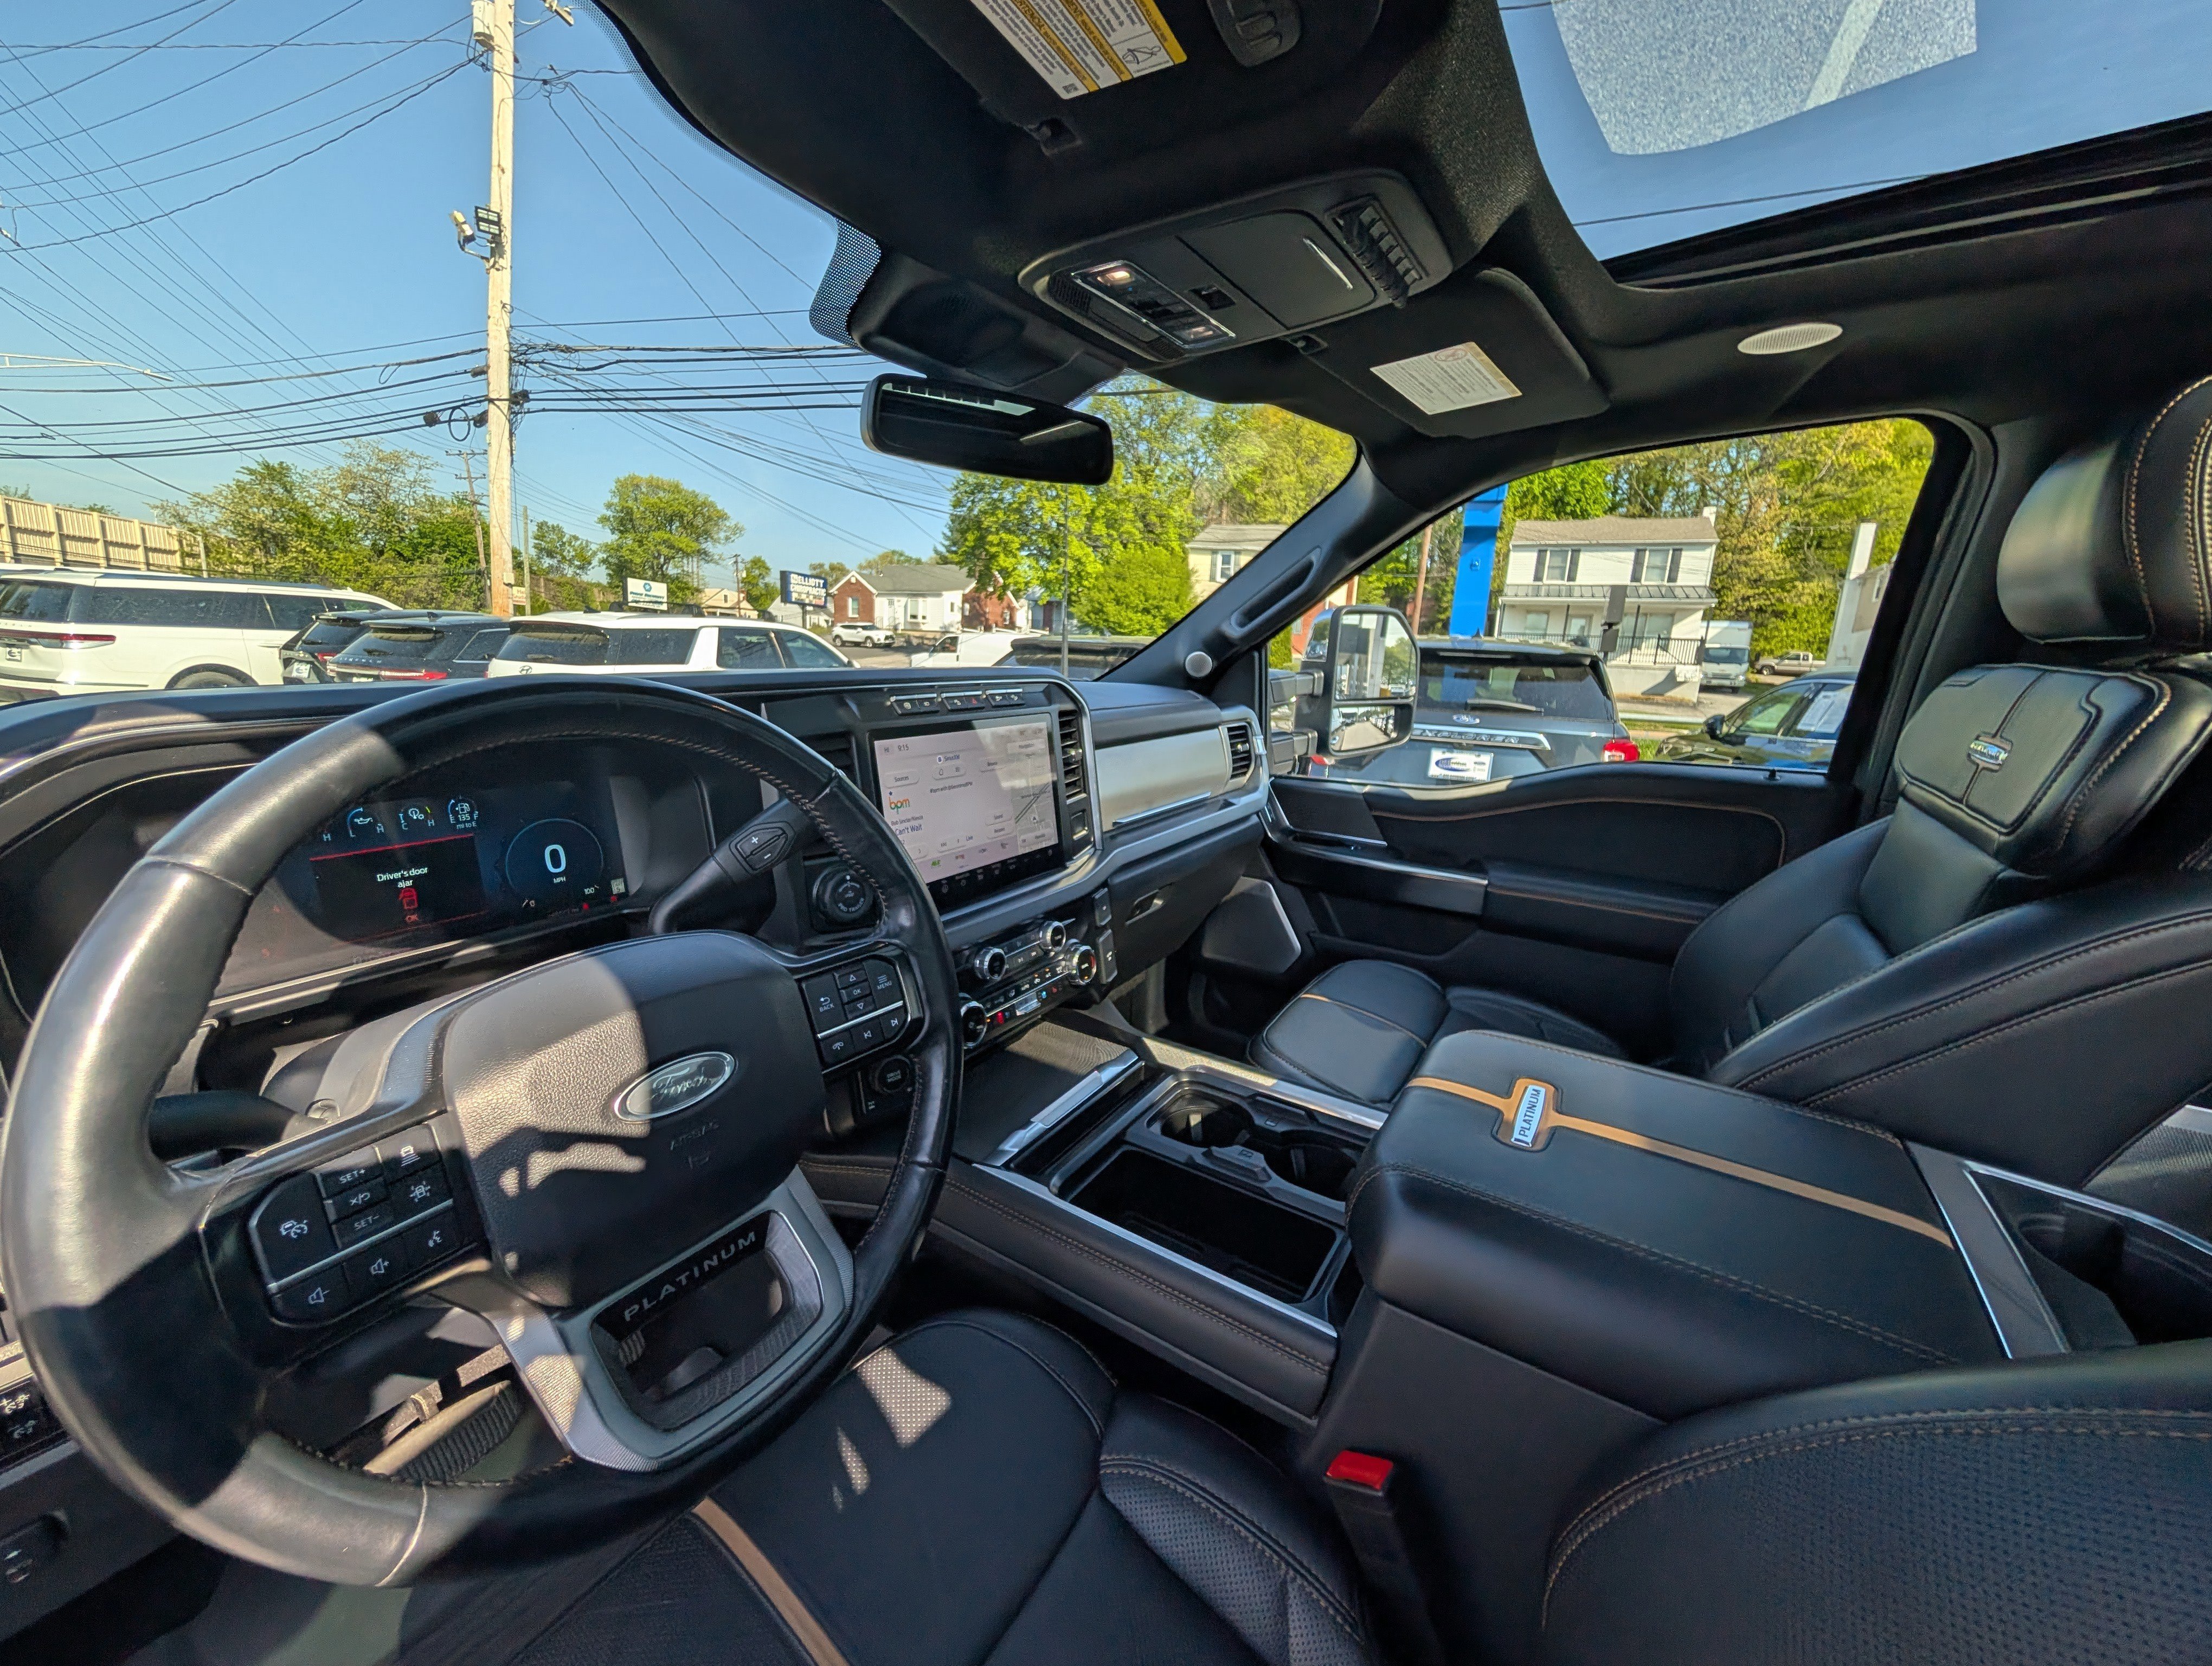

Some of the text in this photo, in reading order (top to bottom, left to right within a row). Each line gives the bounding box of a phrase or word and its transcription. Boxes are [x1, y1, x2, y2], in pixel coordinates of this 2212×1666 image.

[798, 575, 825, 588] ELLIOTT
[1412, 729, 1520, 744] EXPLORER
[888, 796, 910, 815] bpm
[910, 823, 923, 833] Wait
[323, 834, 331, 842] H
[544, 844, 567, 873] 0
[376, 867, 428, 882] Driver's door
[397, 880, 413, 888] ajar
[876, 981, 892, 990] MENU
[819, 1003, 834, 1013] BACK
[1518, 1088, 1541, 1138] PLATINUM
[624, 1231, 756, 1322] PLATINUM
